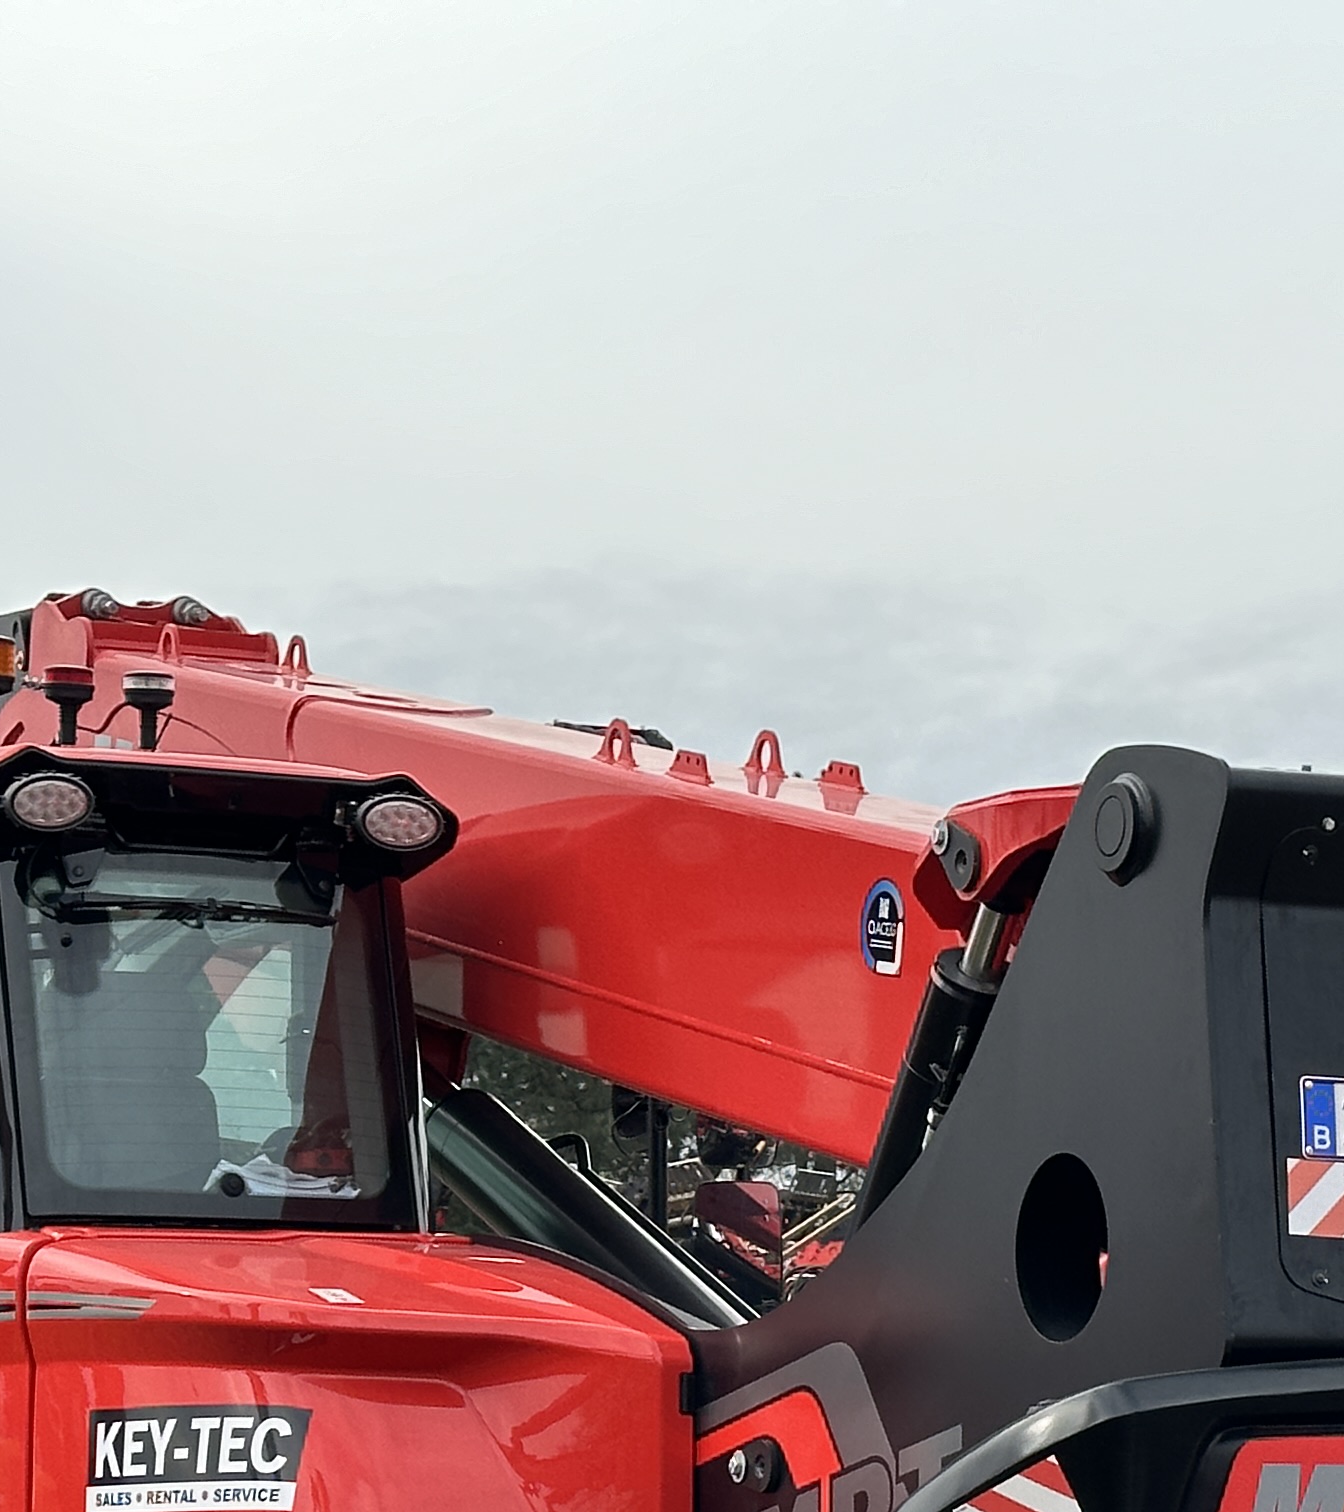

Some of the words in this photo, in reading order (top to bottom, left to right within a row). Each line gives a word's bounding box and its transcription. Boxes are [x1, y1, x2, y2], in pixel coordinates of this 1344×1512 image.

[1313, 1125, 1331, 1149] B
[94, 1416, 293, 1479] KEY-TEC
[96, 1492, 132, 1507] SALES
[146, 1489, 197, 1505] RENTAL
[213, 1488, 281, 1503] SERVICE
